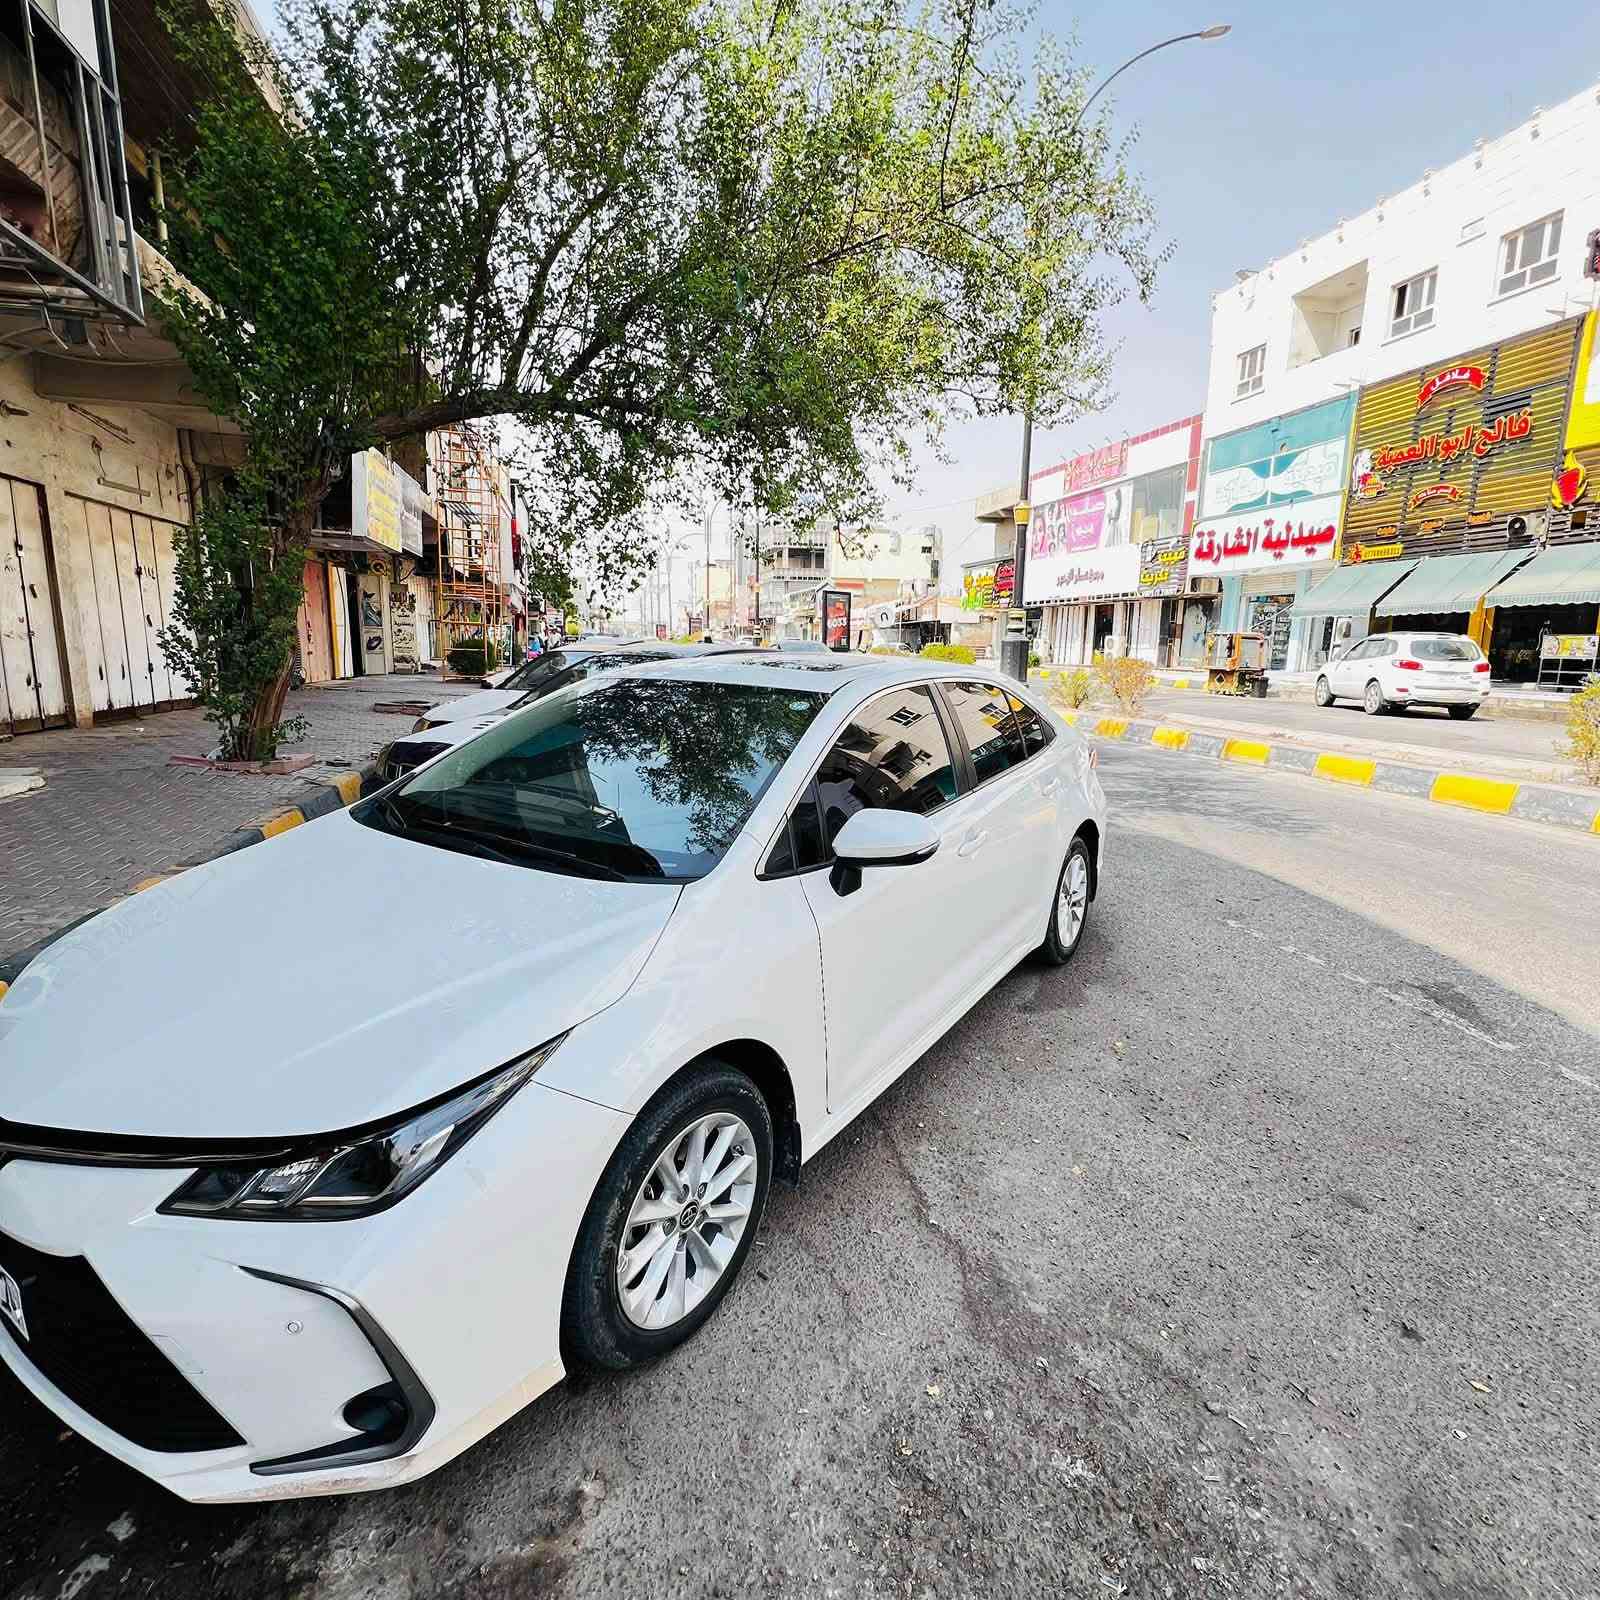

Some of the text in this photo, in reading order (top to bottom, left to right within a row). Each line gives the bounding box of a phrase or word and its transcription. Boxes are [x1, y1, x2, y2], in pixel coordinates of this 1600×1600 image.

[1431, 369, 1470, 391] فلافل
[1438, 425, 1473, 460] ابو
[1473, 408, 1533, 456] فالح
[1194, 518, 1336, 565] صيدلية الشارقة
